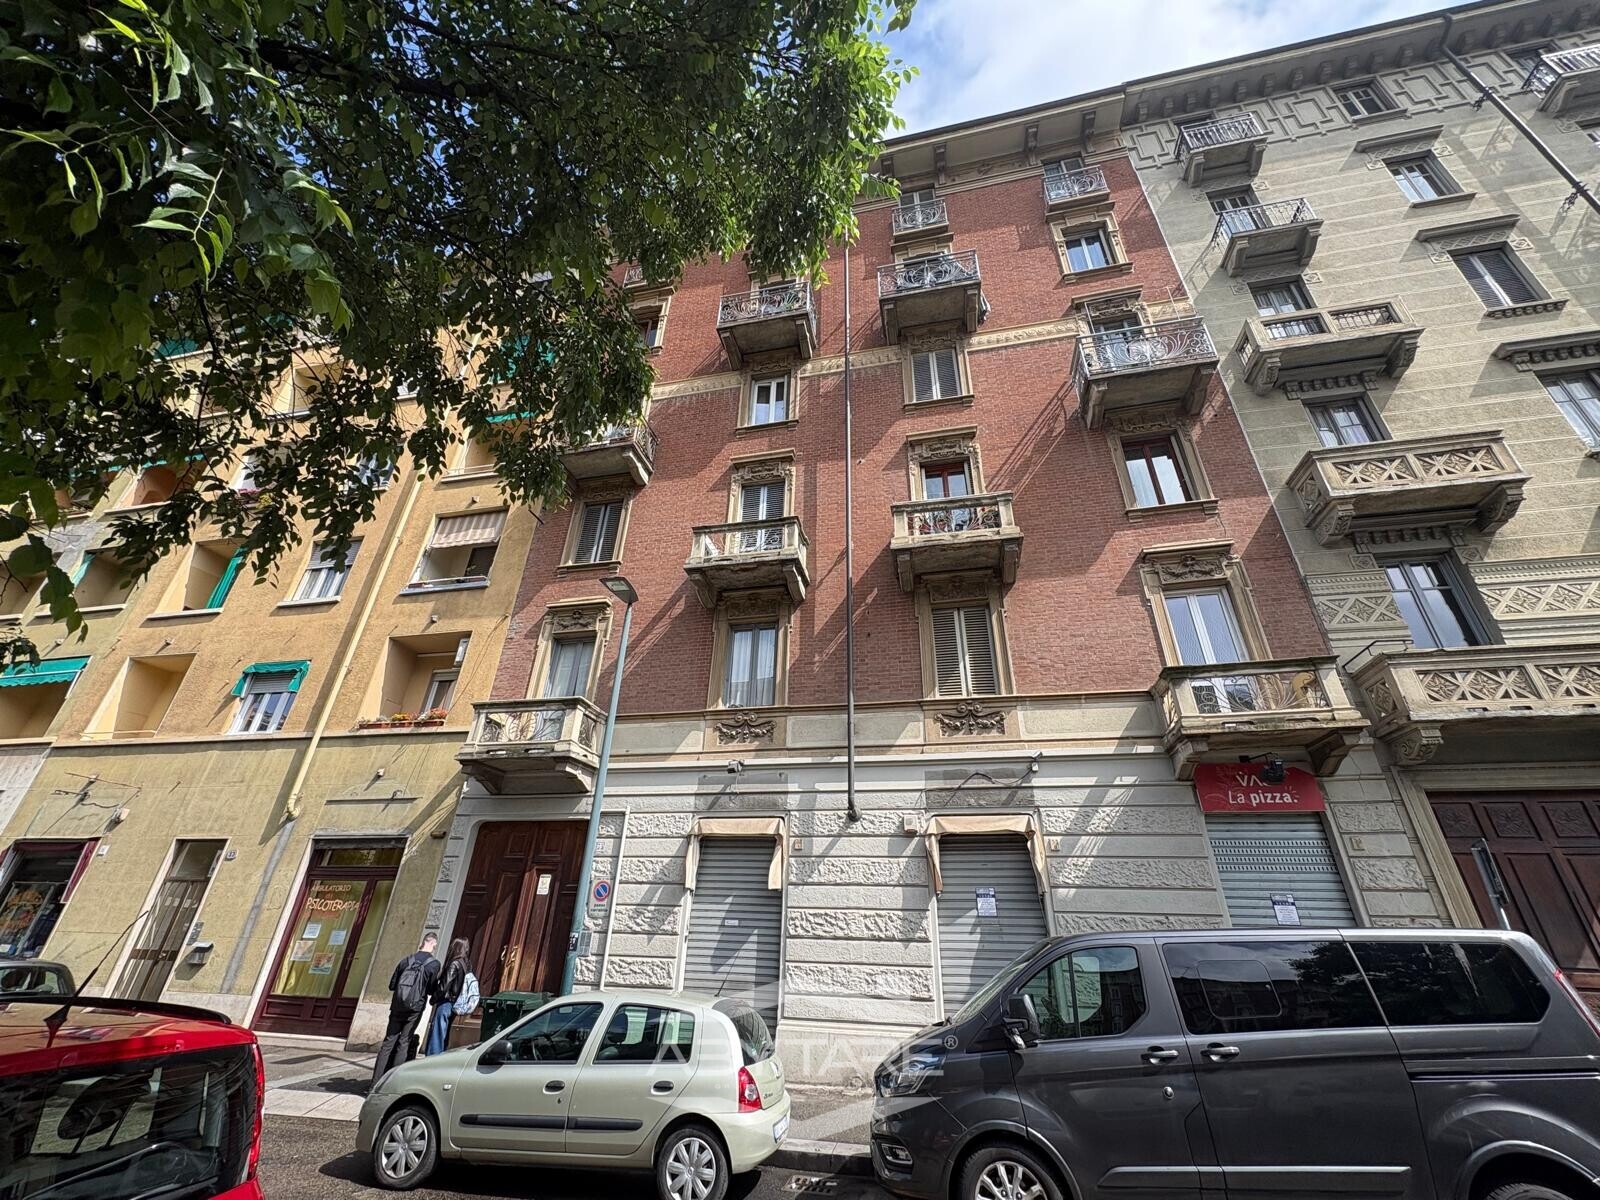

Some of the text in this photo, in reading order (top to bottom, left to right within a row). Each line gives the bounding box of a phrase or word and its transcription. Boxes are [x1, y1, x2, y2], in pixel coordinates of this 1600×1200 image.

[1228, 789, 1299, 807] La pizza.
[305, 897, 360, 911] PSICOTERAPIA
